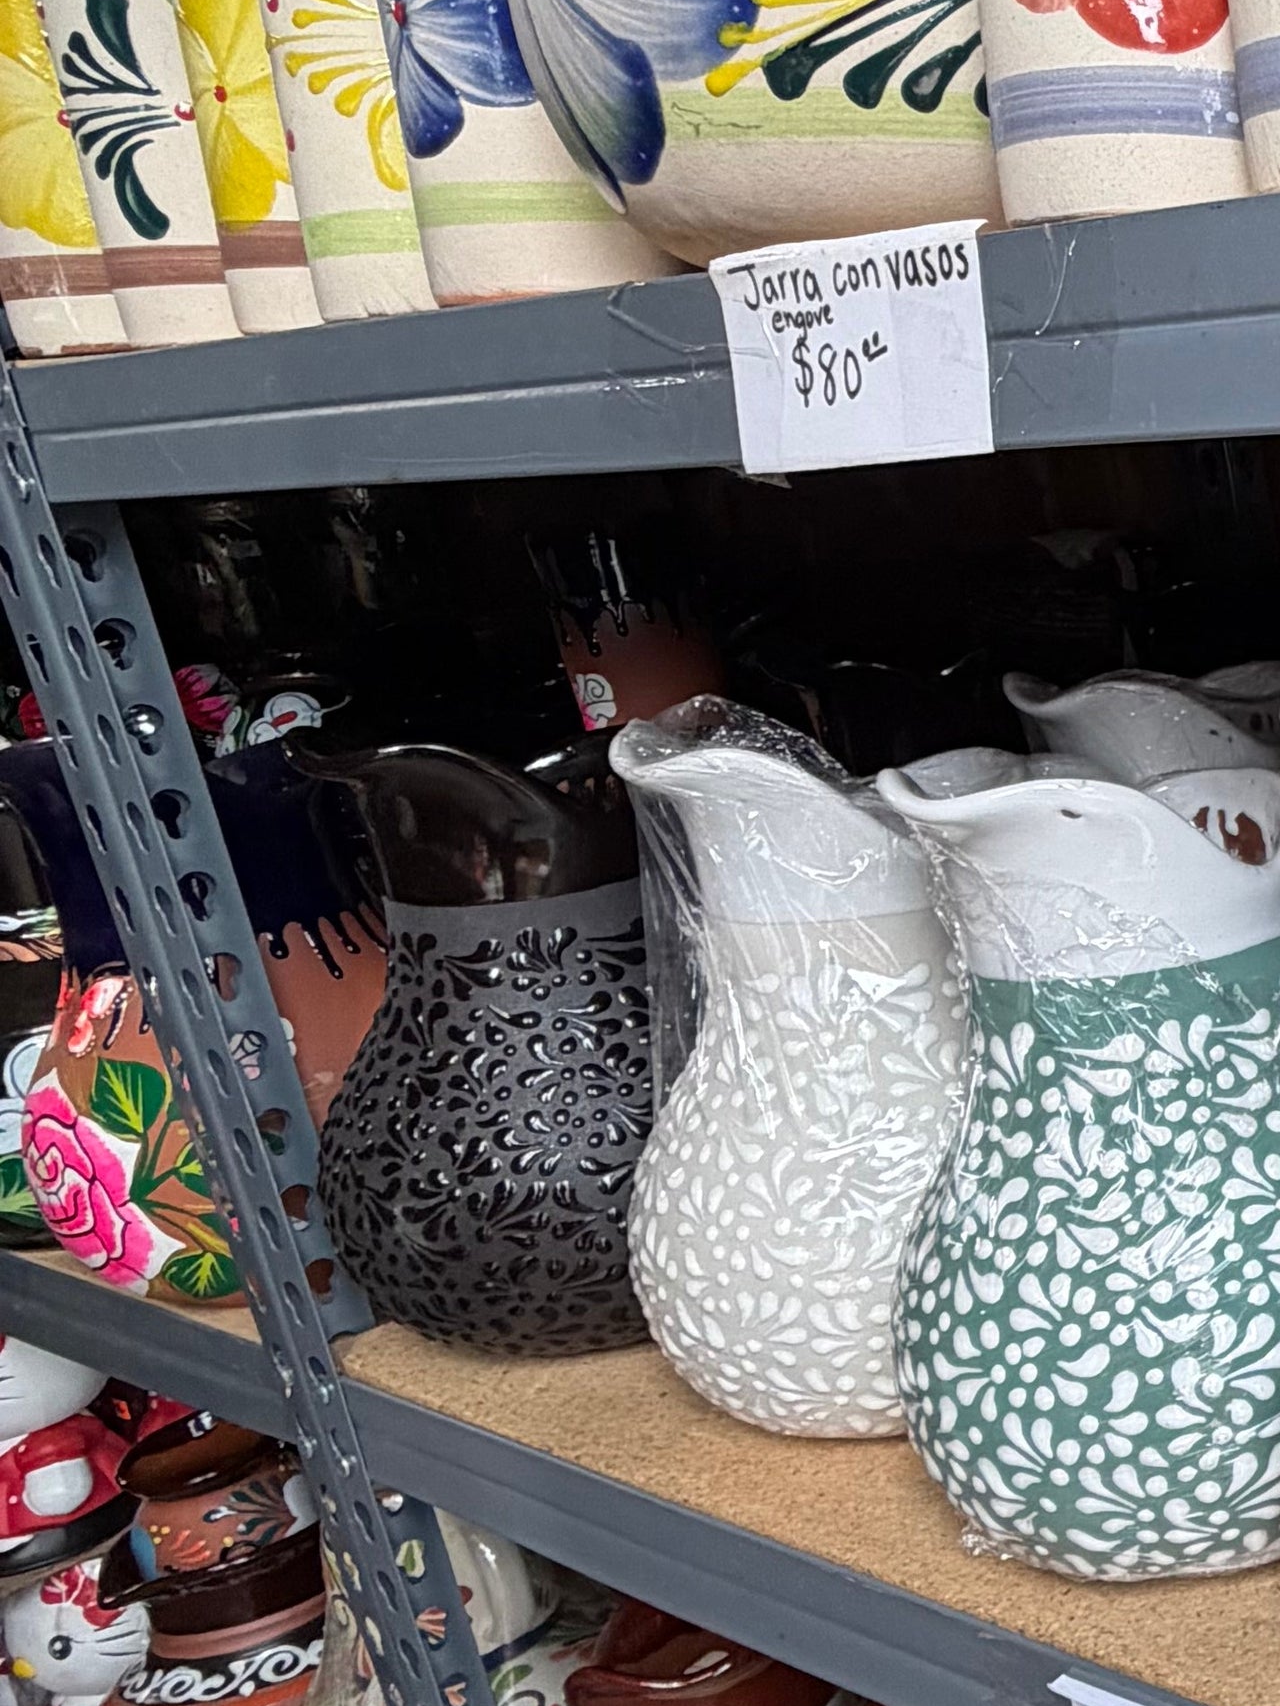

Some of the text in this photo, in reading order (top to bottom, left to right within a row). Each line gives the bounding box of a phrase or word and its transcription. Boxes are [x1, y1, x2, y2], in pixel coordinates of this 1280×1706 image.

[727, 242, 970, 311] Jarra con vasos
